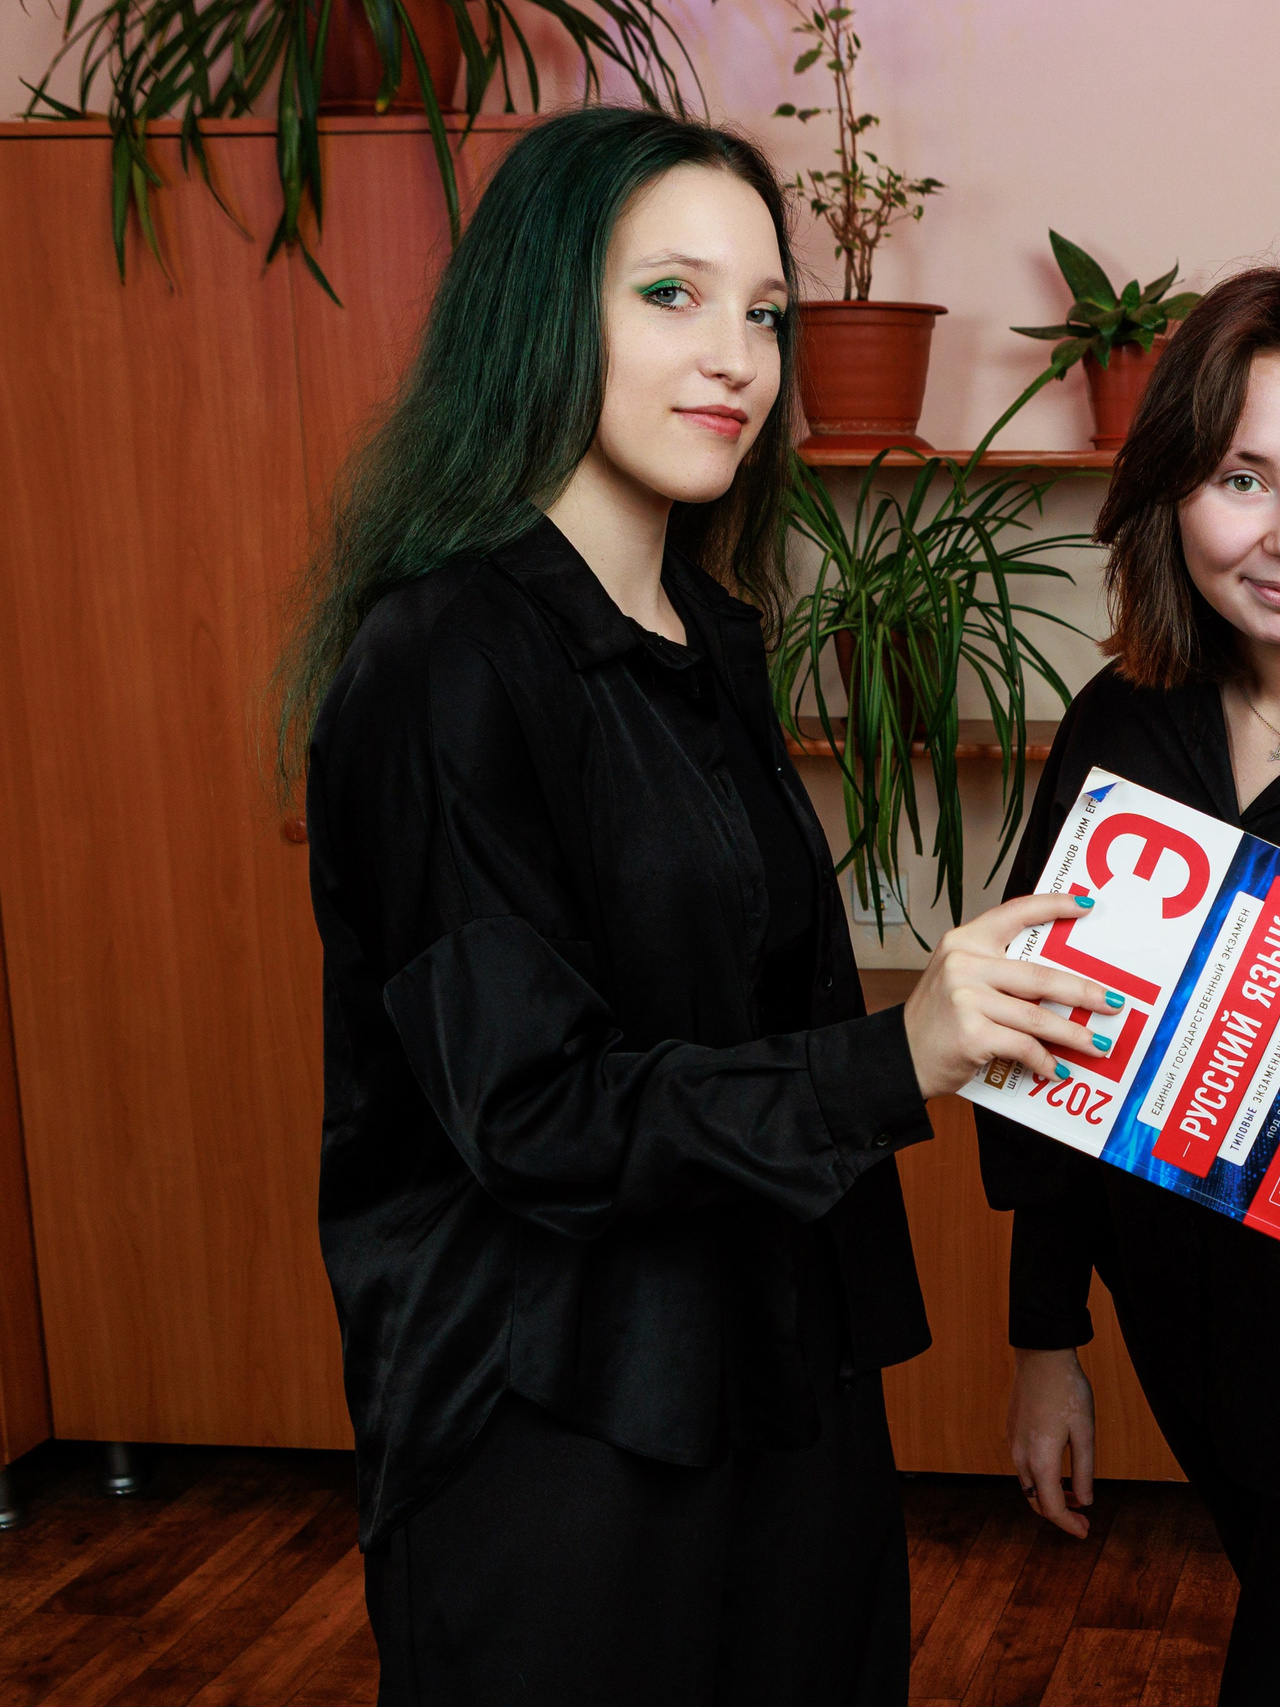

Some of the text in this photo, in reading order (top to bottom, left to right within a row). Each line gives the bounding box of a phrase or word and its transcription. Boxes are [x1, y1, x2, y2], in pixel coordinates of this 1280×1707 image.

[1072, 815, 1091, 841] КИМ
[1149, 906, 1251, 1116] ЕДИНЫЙ ГОСУДАРСТВЕННЫЙ ЭКЗАМЕН
[988, 1054, 1011, 1085] ФИП
[1178, 1009, 1263, 1142] РУССКИЙ
[1229, 1105, 1257, 1152] ТИПОВЫЕ
